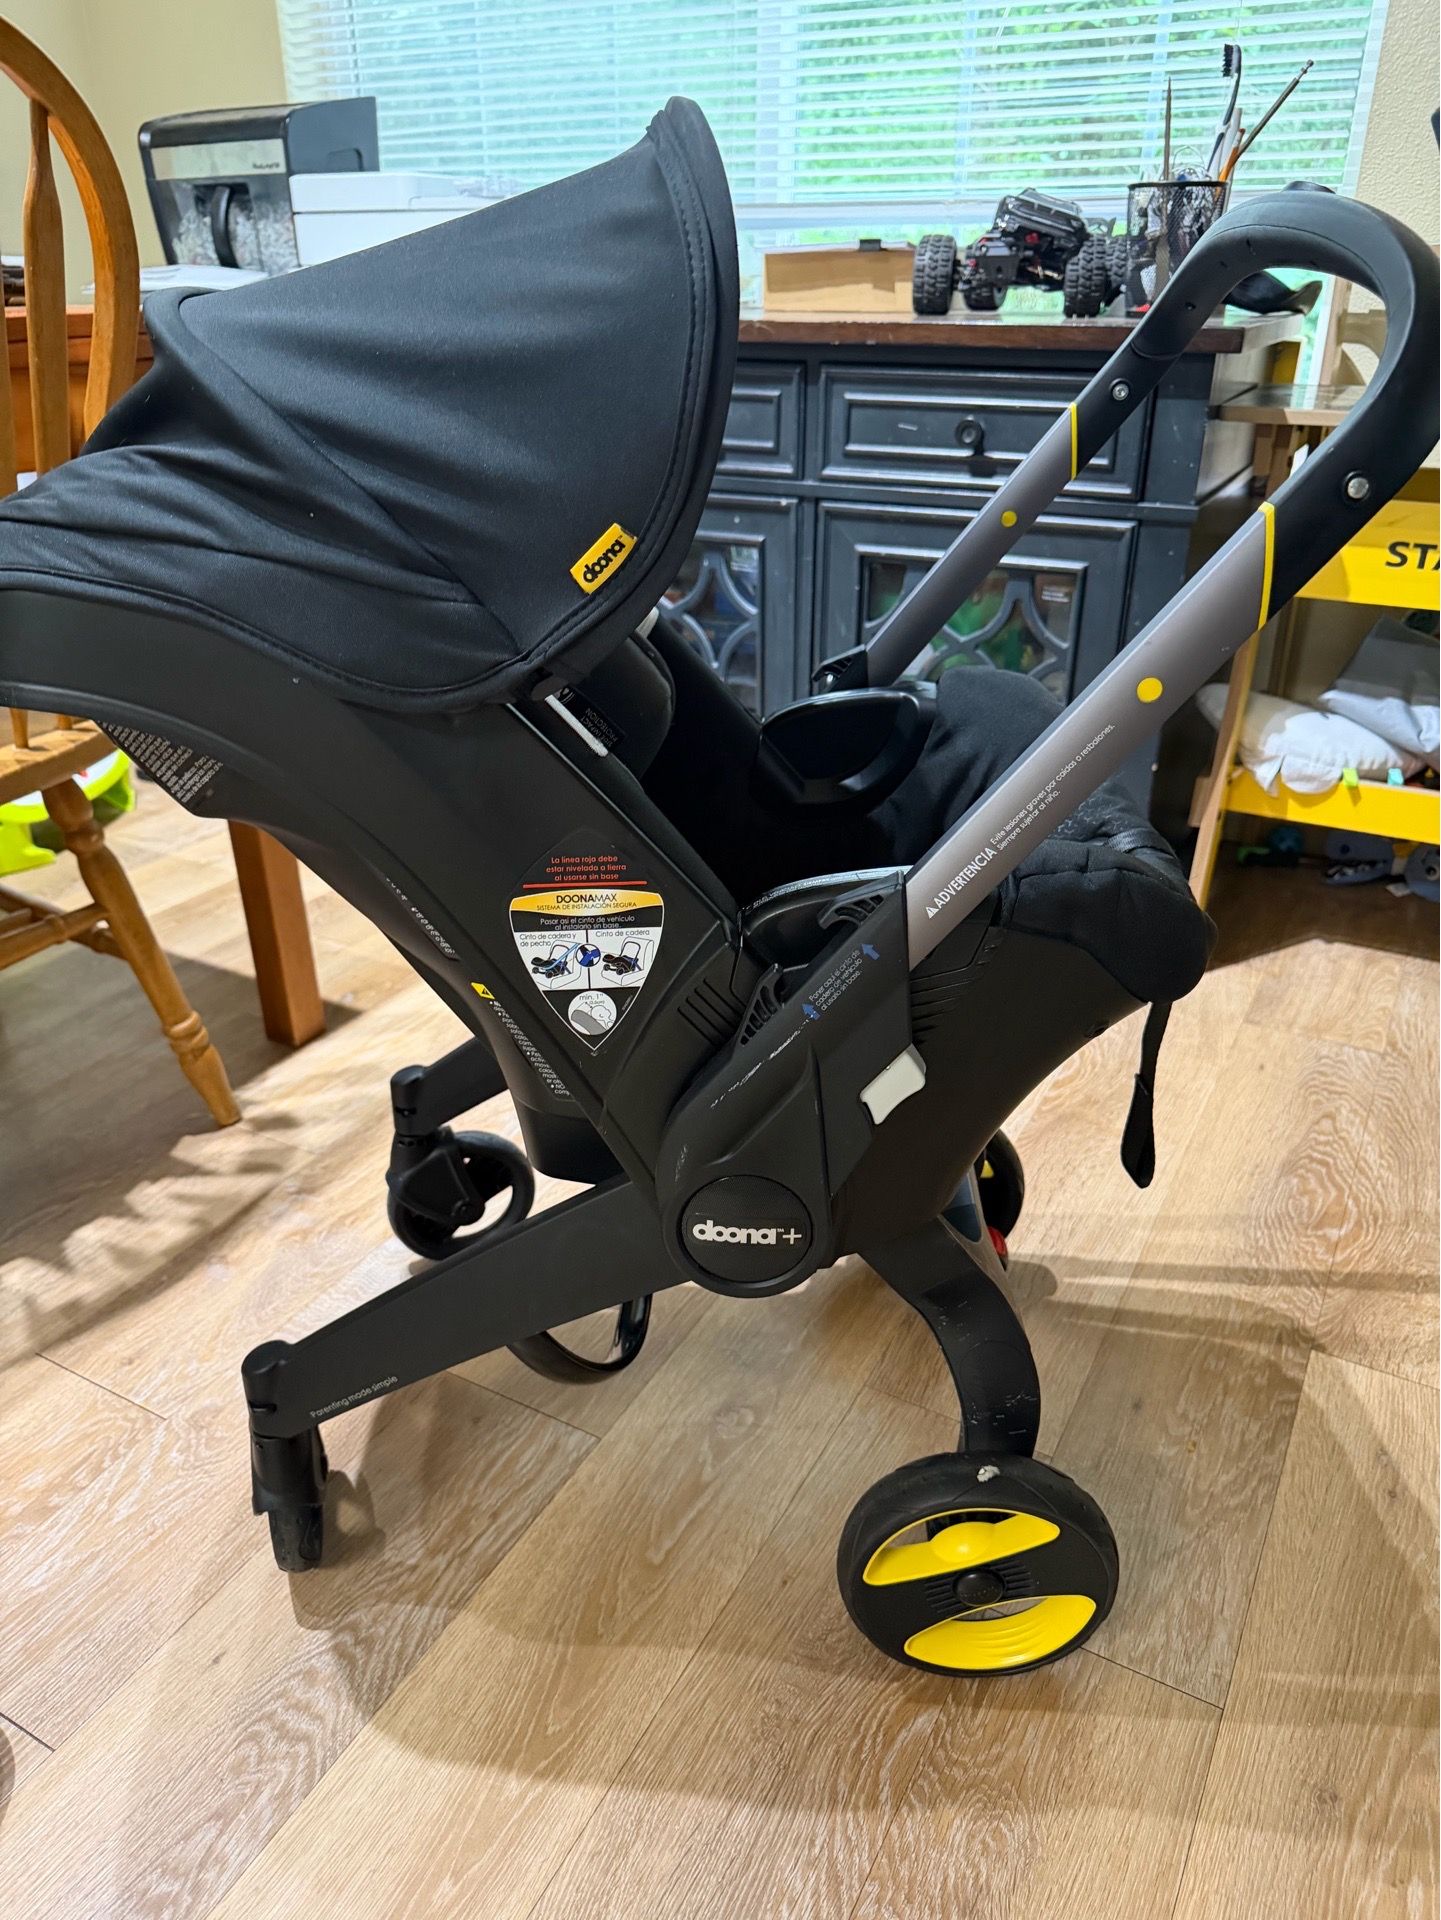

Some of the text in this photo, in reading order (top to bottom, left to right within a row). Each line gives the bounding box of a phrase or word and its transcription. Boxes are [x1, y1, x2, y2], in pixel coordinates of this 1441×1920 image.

[583, 538, 626, 583] doona
[1385, 541, 1440, 571] ST
[990, 830, 1006, 845] Evite
[1003, 809, 1028, 832] lesiones
[1026, 791, 1047, 811] graves
[1045, 779, 1057, 792] por
[997, 827, 1021, 851] Siempre
[1019, 808, 1040, 829] sujetar
[566, 864, 599, 872] nivelada
[582, 855, 597, 864] roja
[600, 872, 619, 880] base
[933, 847, 998, 909] ADVERTENCIA
[556, 893, 618, 904] DOONAMAX
[530, 940, 552, 948] pecho
[309, 1376, 398, 1418] Parenting made simple
